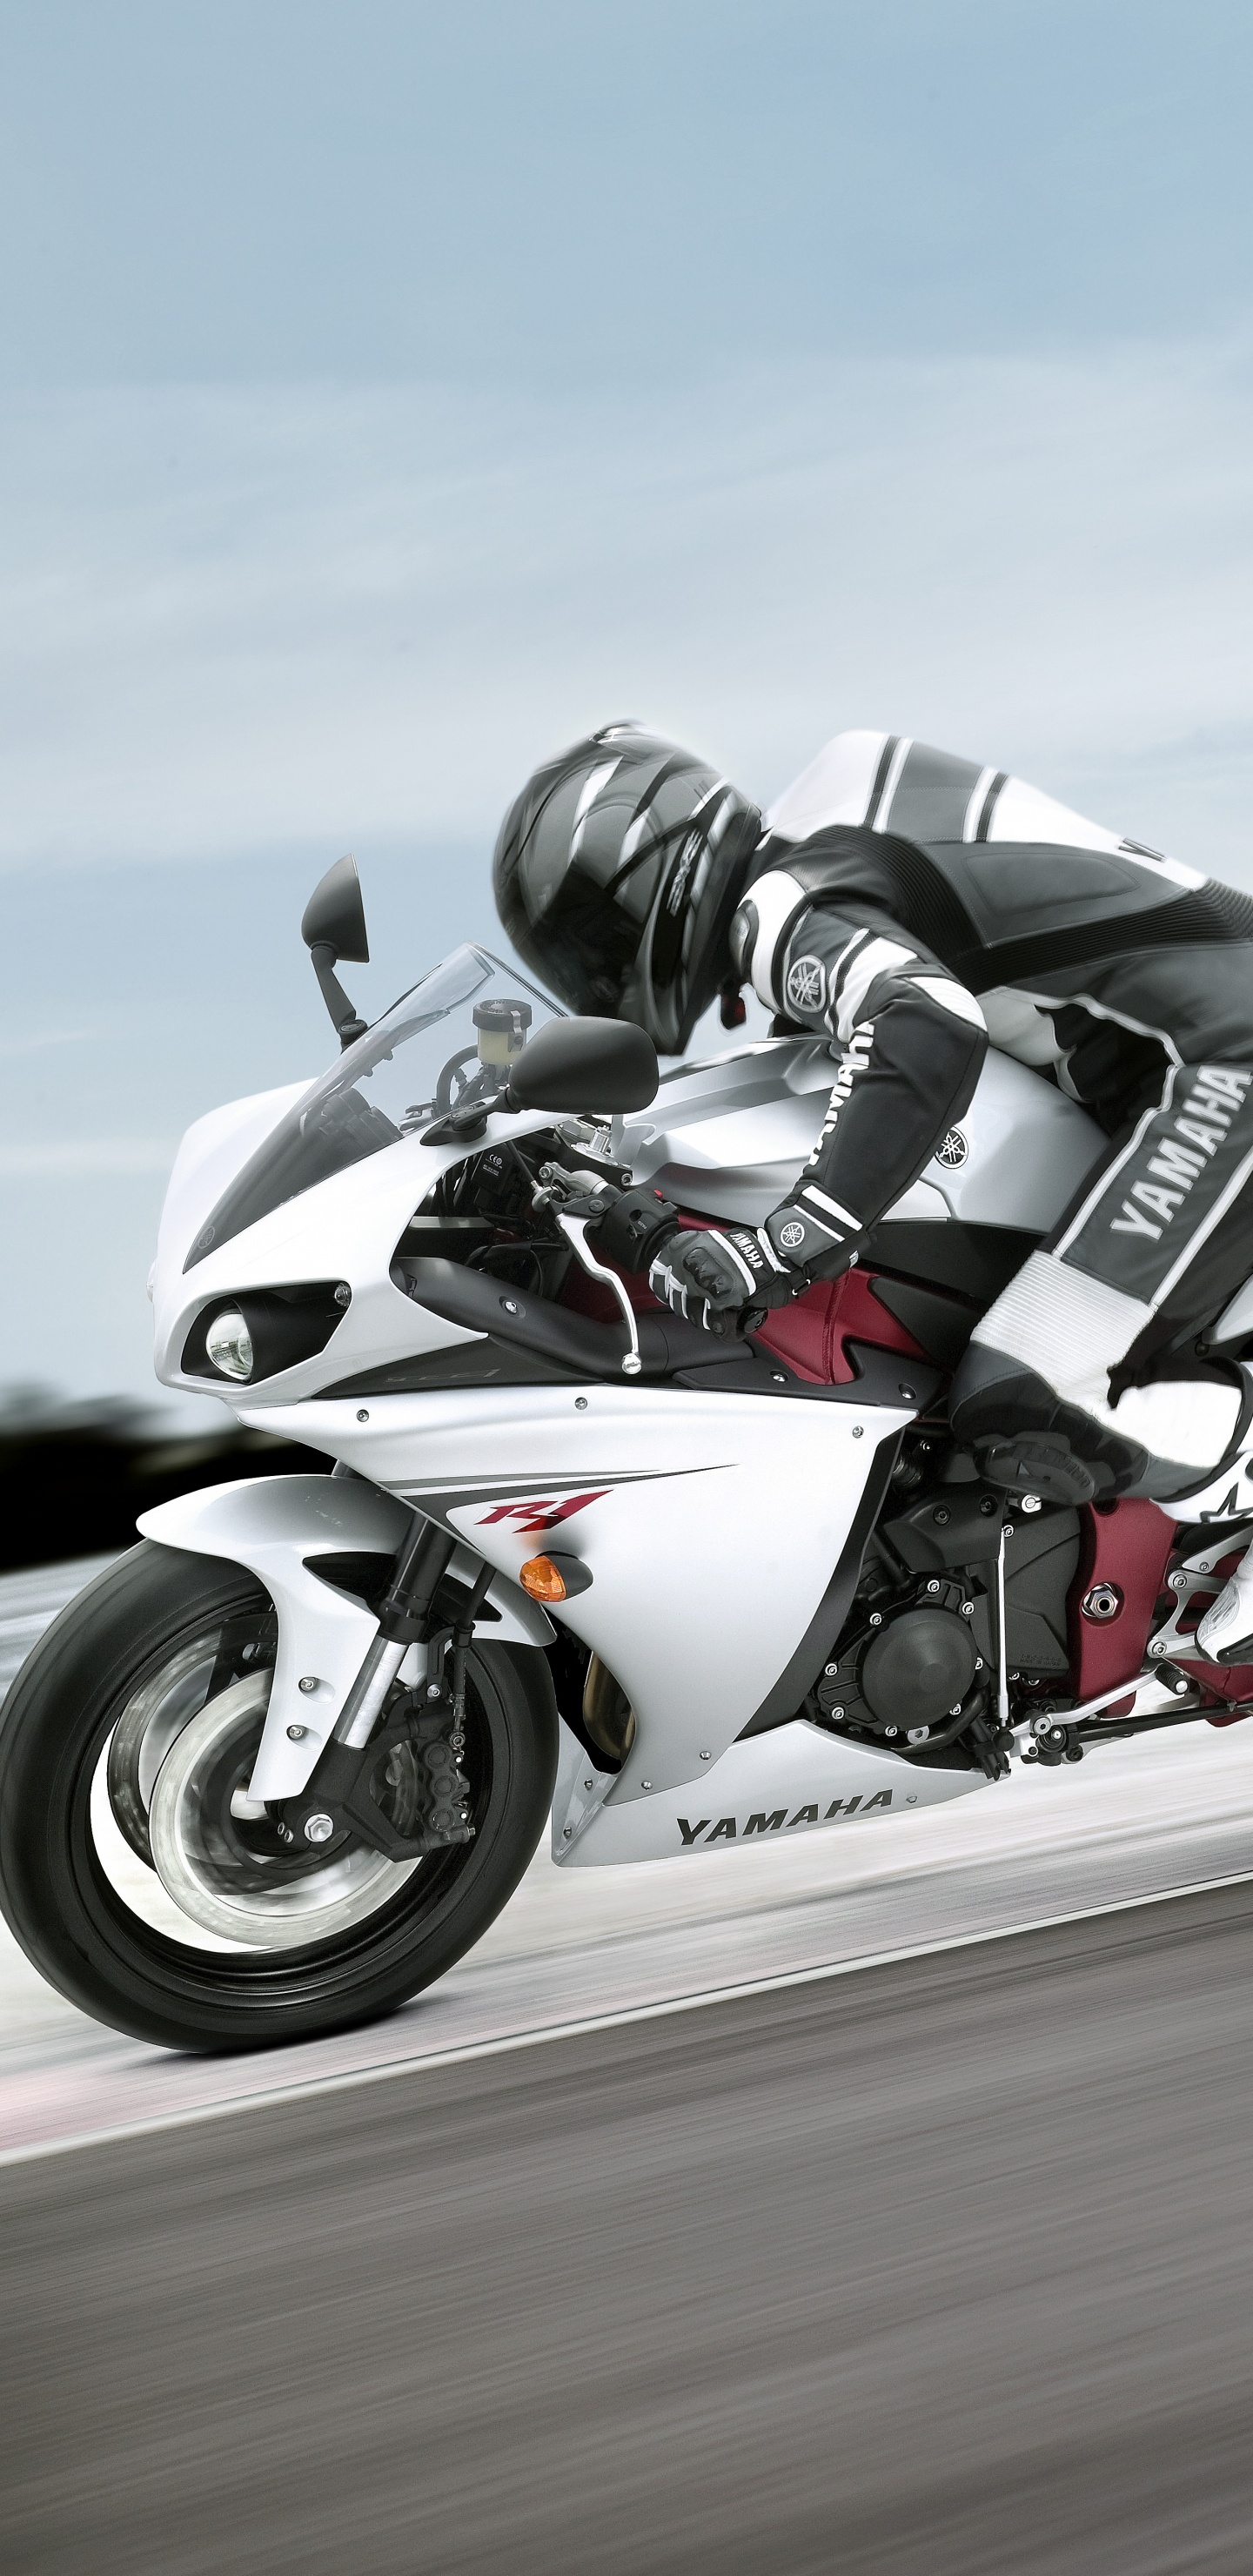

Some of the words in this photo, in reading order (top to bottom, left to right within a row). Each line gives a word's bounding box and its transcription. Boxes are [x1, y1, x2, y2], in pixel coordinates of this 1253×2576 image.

[1109, 1064, 1253, 1241] YAMAHA
[730, 1232, 764, 1269] YAMAHA
[473, 1489, 614, 1534] R1
[676, 1788, 894, 1846] YAMAHA
